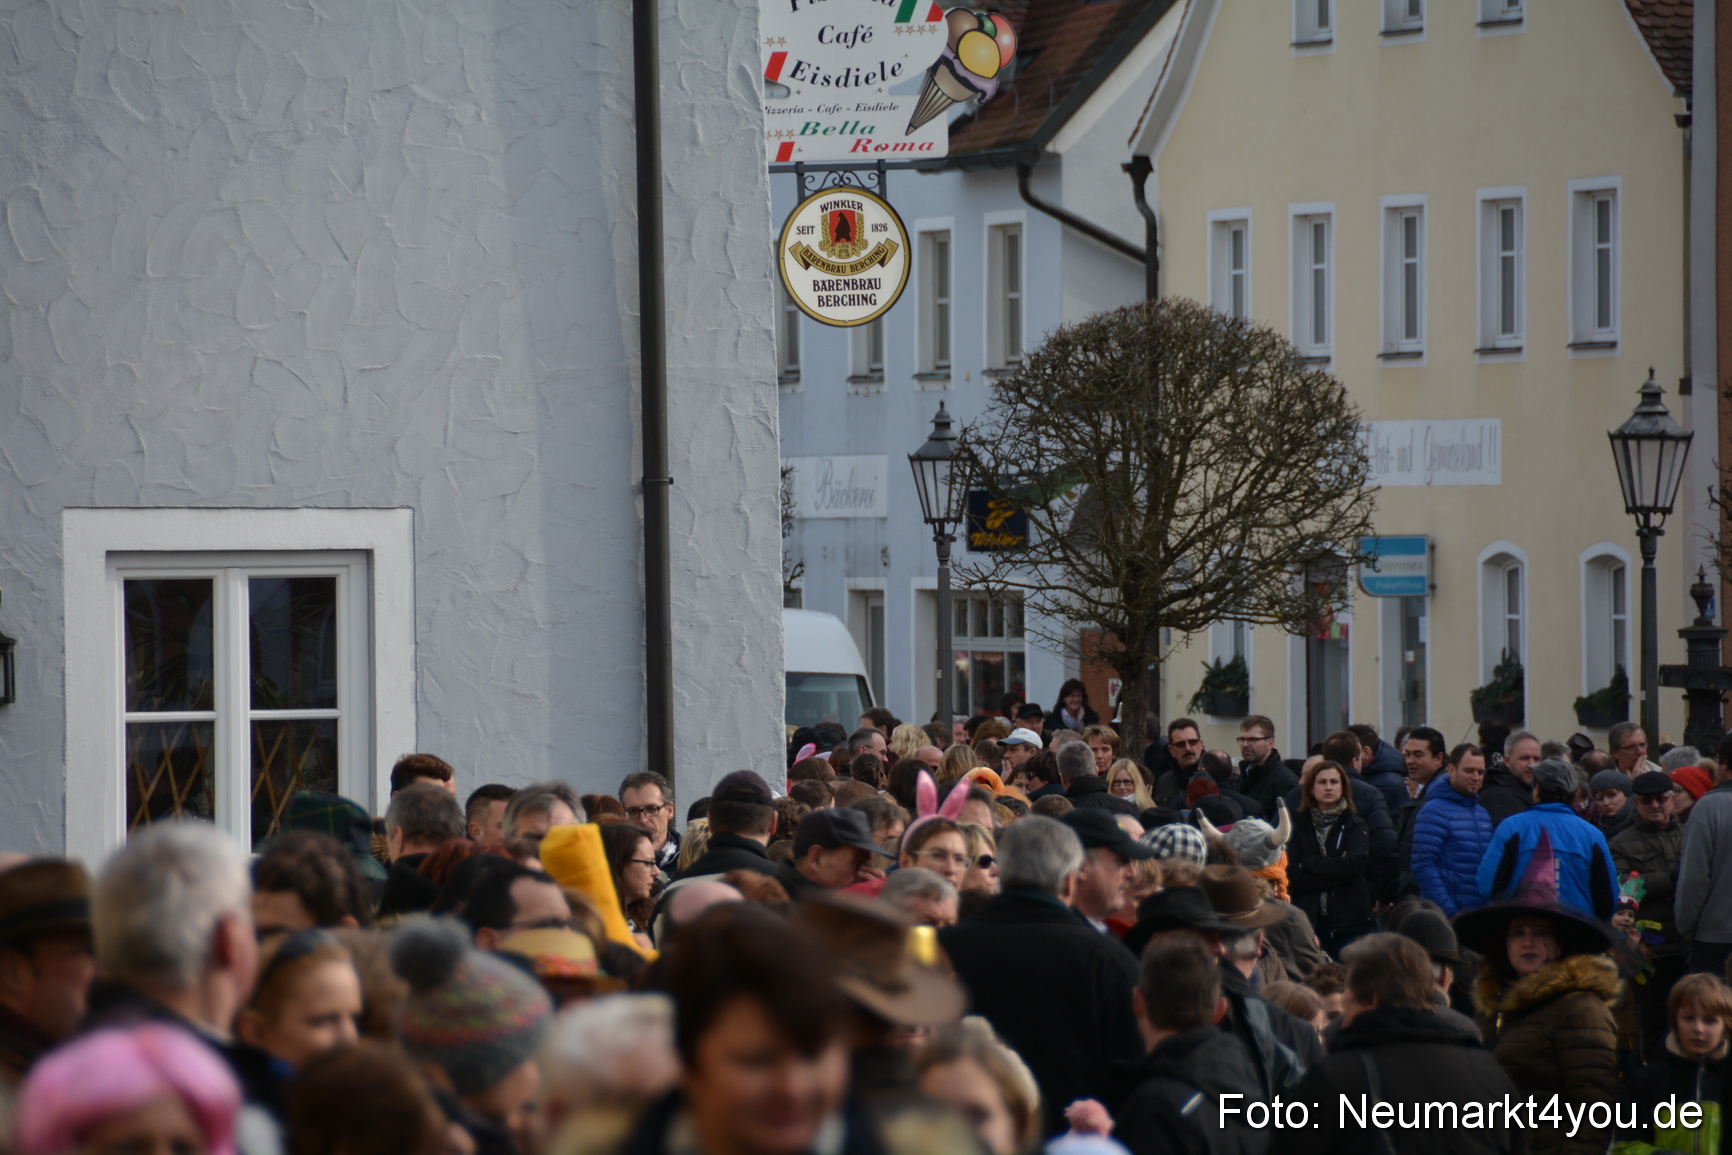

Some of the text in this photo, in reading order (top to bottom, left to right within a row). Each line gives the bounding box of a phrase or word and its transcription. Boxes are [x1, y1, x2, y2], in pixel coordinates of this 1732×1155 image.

[817, 24, 873, 49] Café
[787, 59, 903, 88] Eisdiele
[817, 103, 843, 115] Cafe
[855, 102, 899, 112] Eisdiele
[798, 120, 876, 136] Bella
[848, 138, 935, 153] Roma
[820, 200, 864, 213] WINKLER
[796, 223, 888, 235] SEIT 1826
[850, 246, 886, 273] BERCHING
[812, 277, 881, 292] BÄRENBRÄU
[817, 293, 877, 308] BERCHING
[814, 458, 878, 511] Bäckerei
